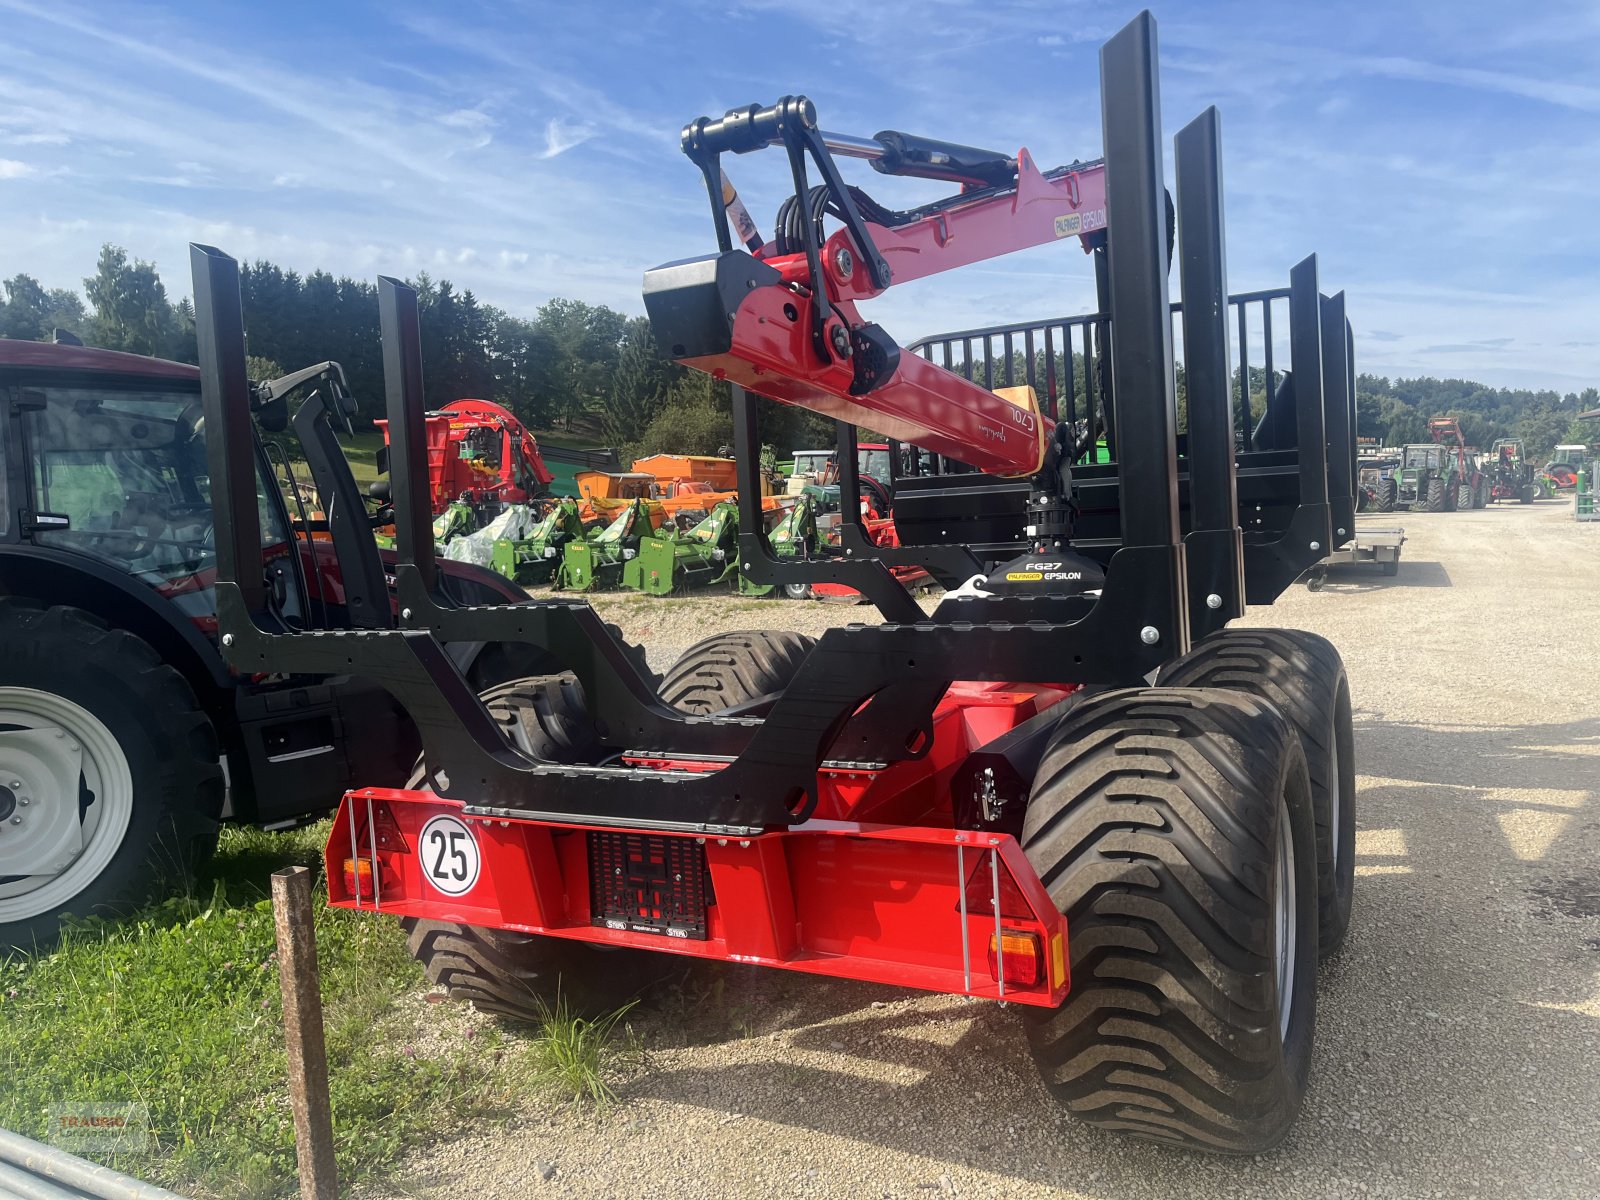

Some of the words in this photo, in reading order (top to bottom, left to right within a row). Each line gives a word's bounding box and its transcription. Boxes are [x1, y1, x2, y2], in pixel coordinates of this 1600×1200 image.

[1055, 215, 1081, 234] PALFINGER
[1083, 207, 1107, 229] EPSILON
[1009, 407, 1034, 432] C70L
[1025, 562, 1063, 571] FG27
[1044, 572, 1081, 580] EPSILON
[430, 829, 468, 882] 25
[606, 920, 626, 930] STEPA
[632, 924, 661, 933] stepakran.com
[667, 927, 688, 938] STEPA
